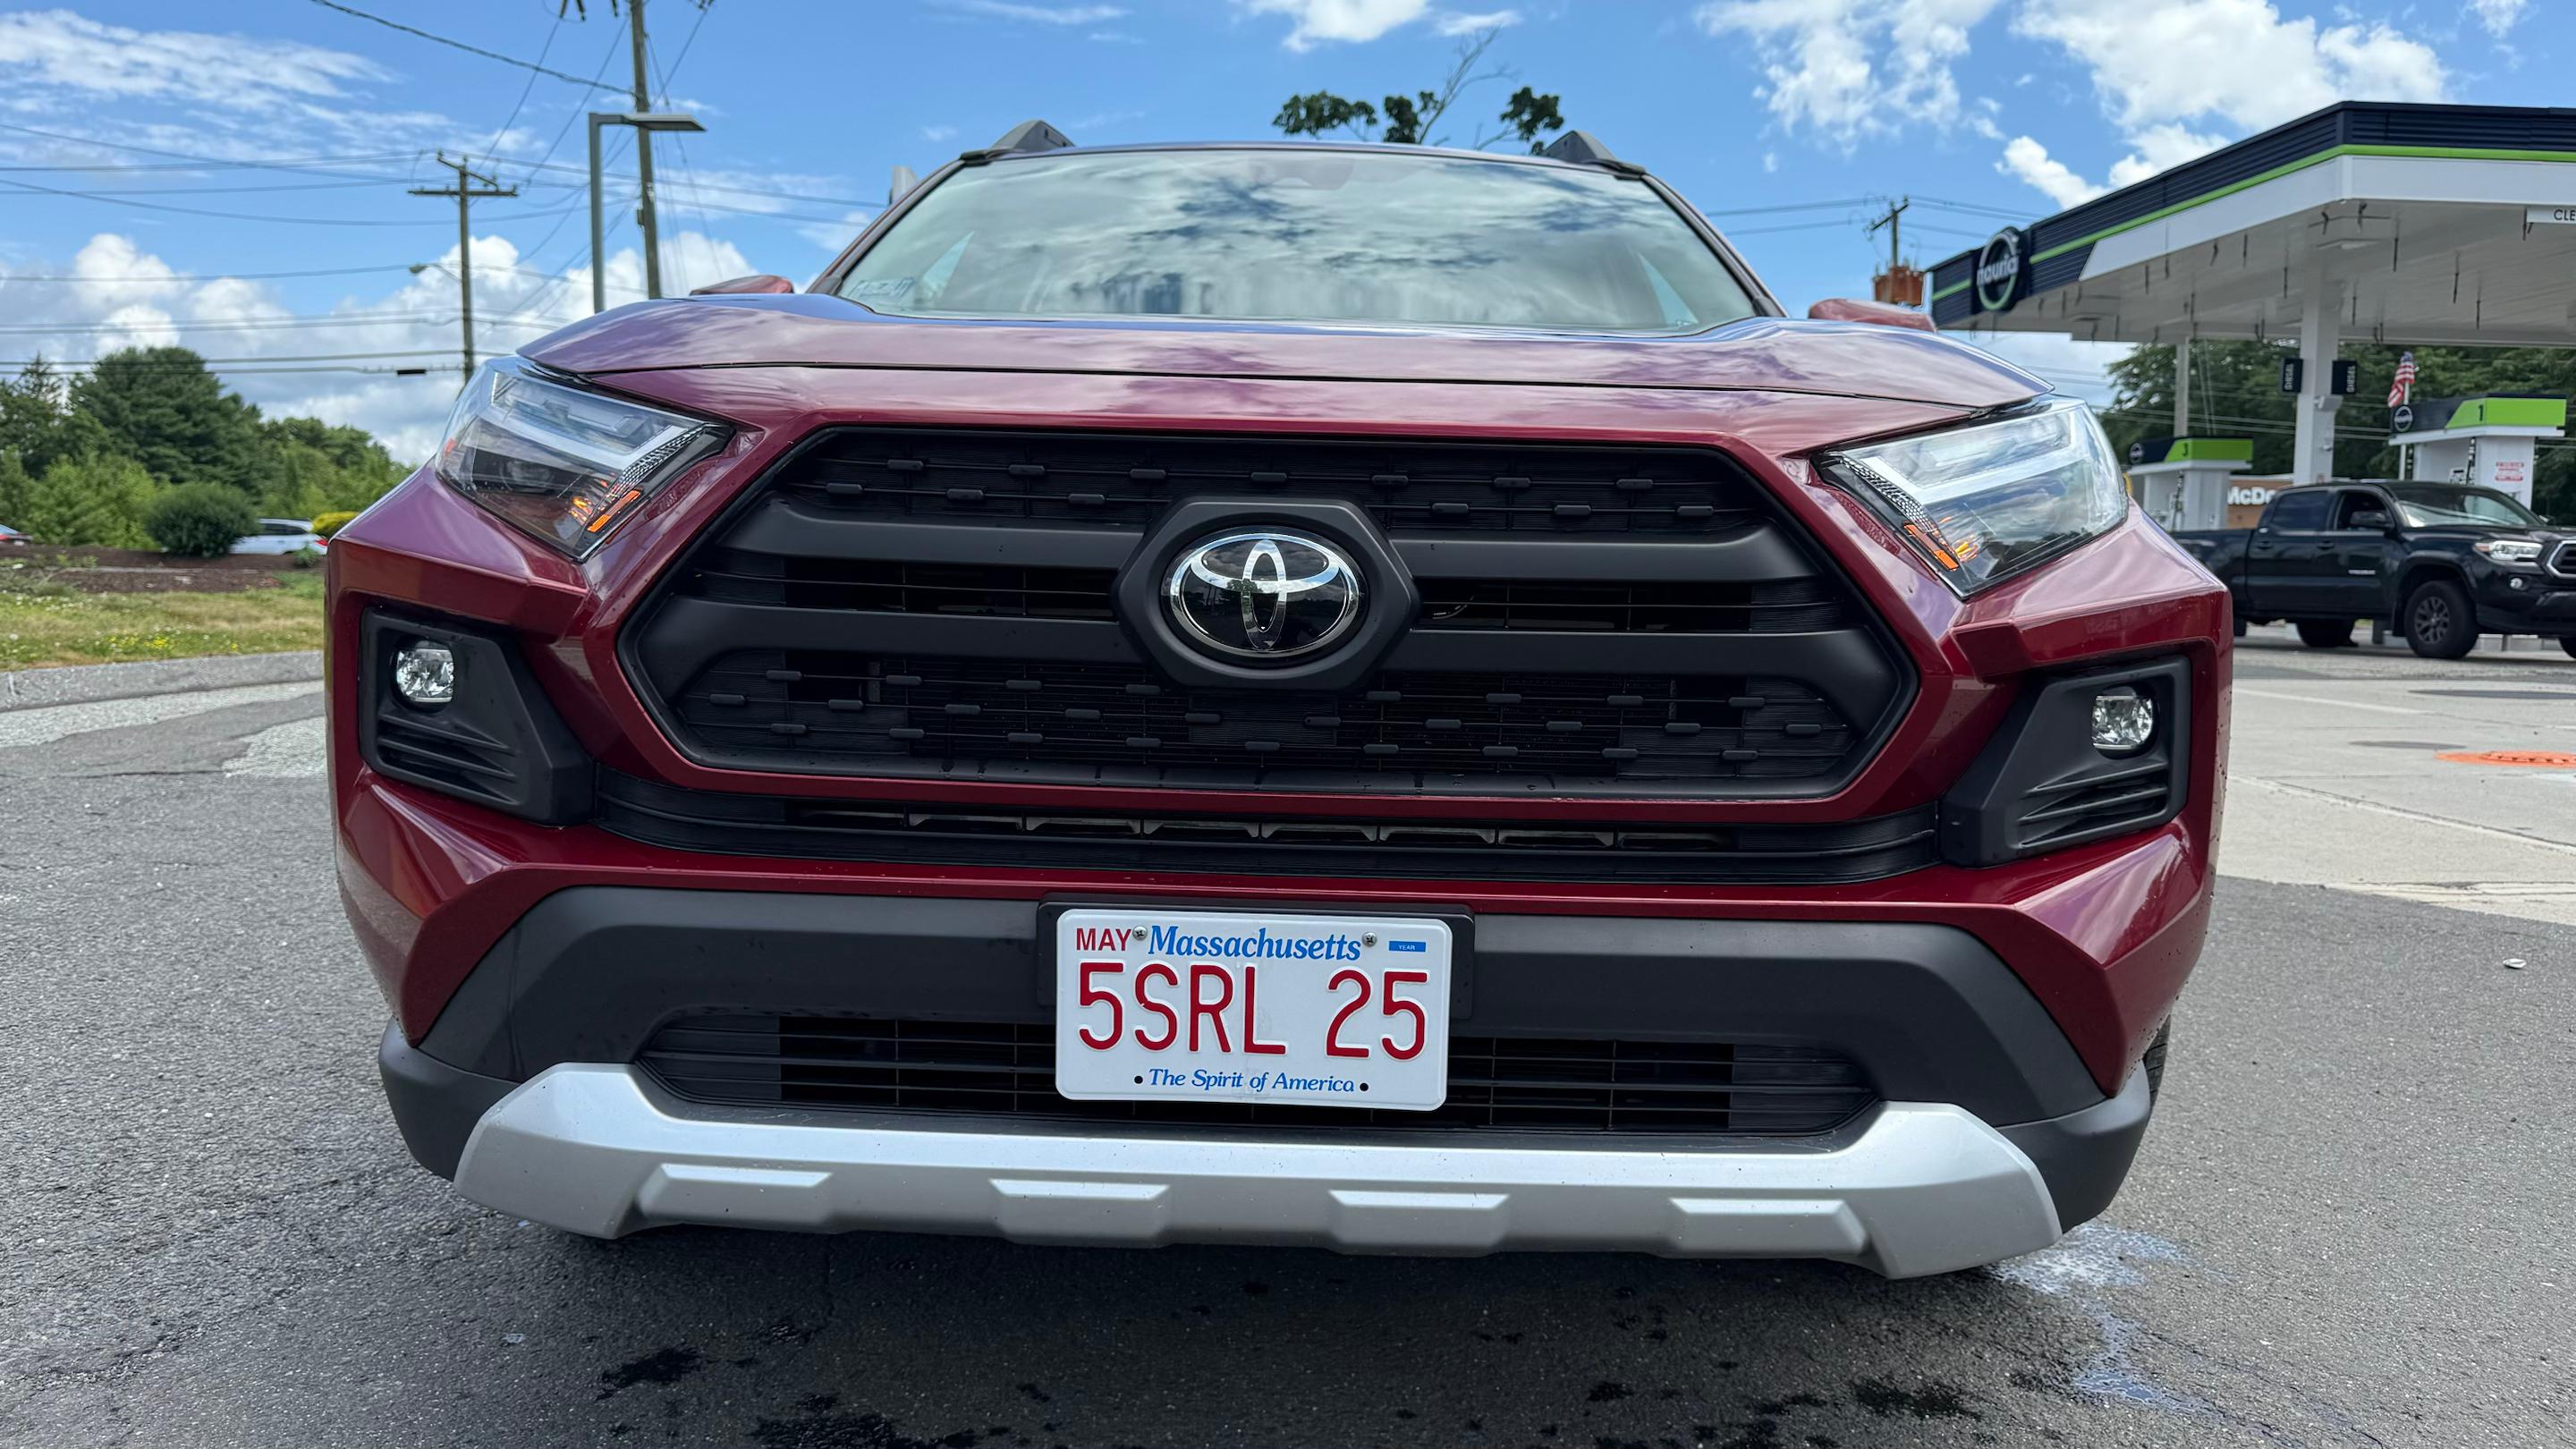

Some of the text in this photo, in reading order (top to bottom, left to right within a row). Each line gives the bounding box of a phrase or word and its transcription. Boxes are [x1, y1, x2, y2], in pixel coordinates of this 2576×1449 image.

[1977, 254, 2019, 286] nouria
[2478, 405, 2484, 422] 1
[2182, 443, 2189, 457] 3
[1076, 928, 1131, 951] MAY
[1148, 925, 1361, 961] Massachusetts
[1079, 962, 1428, 1060] 5SRL 25
[1148, 1068, 1355, 1092] The Spirit of America
